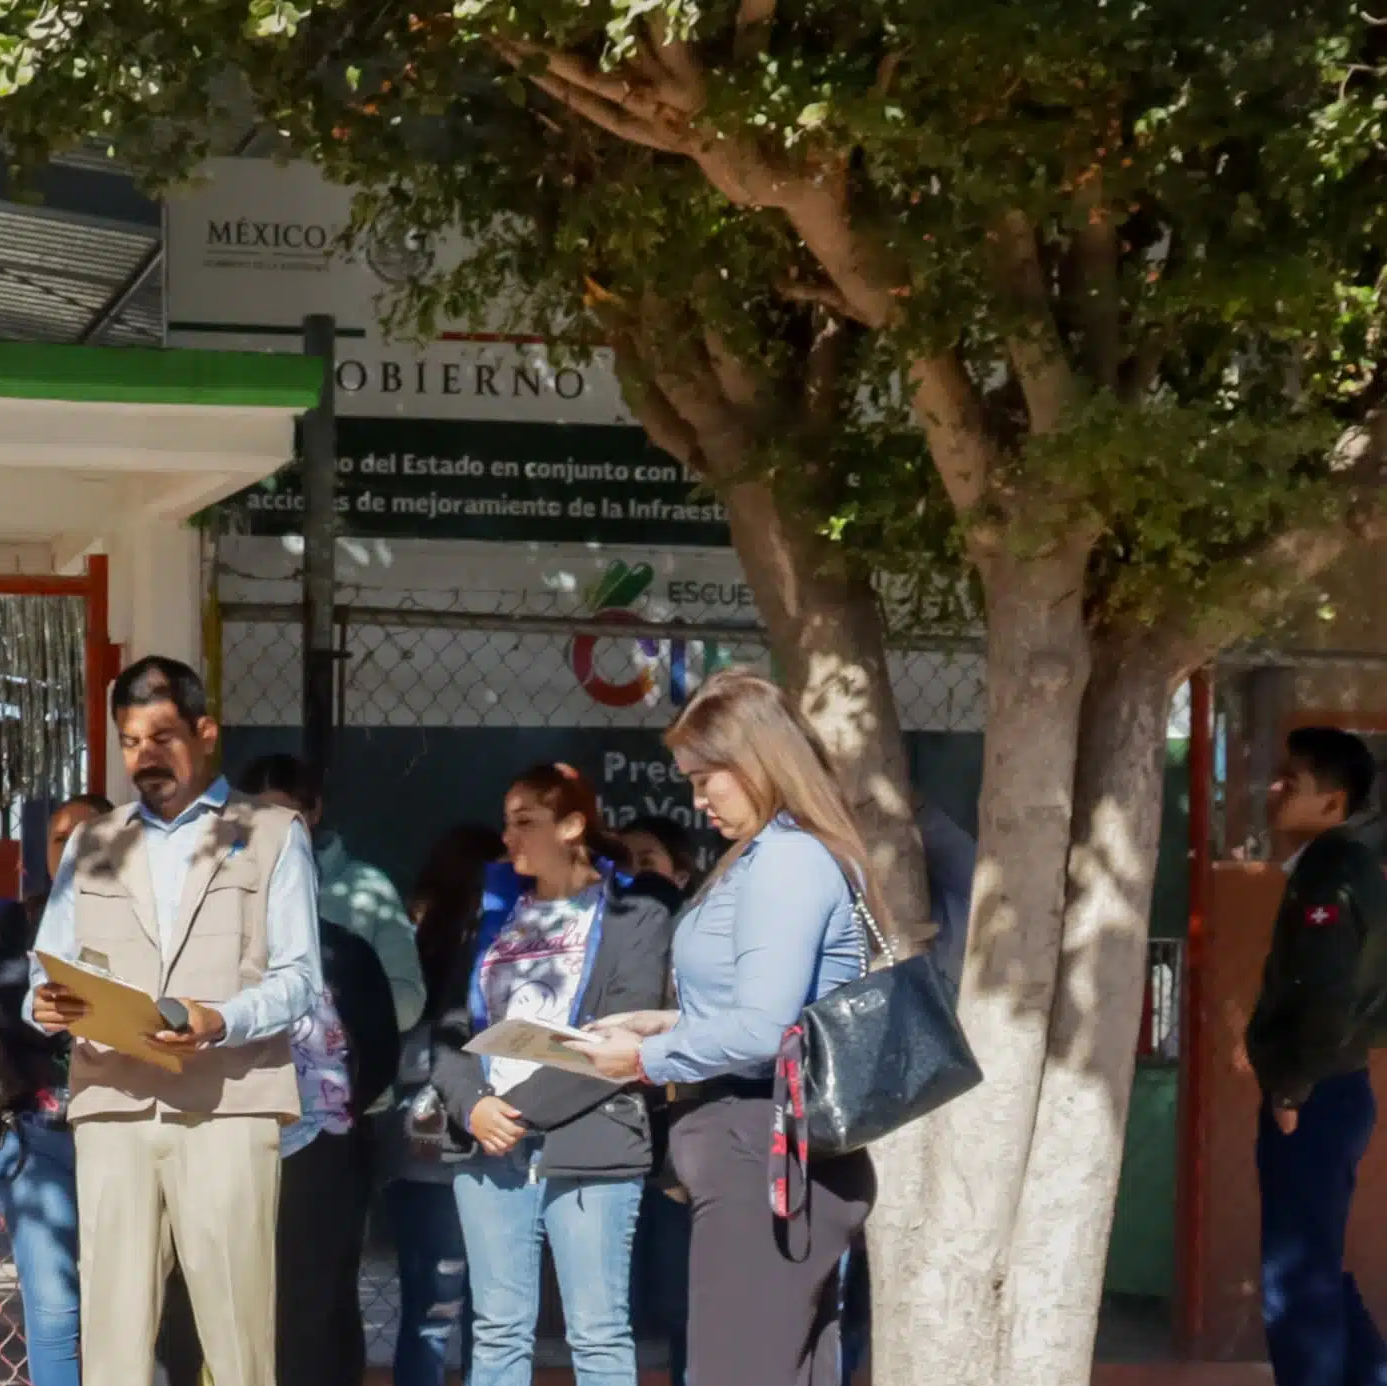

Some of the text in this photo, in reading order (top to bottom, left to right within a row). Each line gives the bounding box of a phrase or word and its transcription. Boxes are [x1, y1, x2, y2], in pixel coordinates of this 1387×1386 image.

[206, 217, 327, 249] MÉXICO
[336, 359, 584, 399] OBIERNO
[360, 453, 396, 474] del
[402, 453, 484, 477] Estado
[490, 459, 520, 477] en
[524, 456, 628, 484] conjunto
[633, 463, 677, 482] con
[356, 490, 386, 513] de
[392, 492, 562, 519] mejoramiento
[567, 496, 596, 518] de
[601, 497, 625, 519] la
[667, 581, 752, 606] ESCUE
